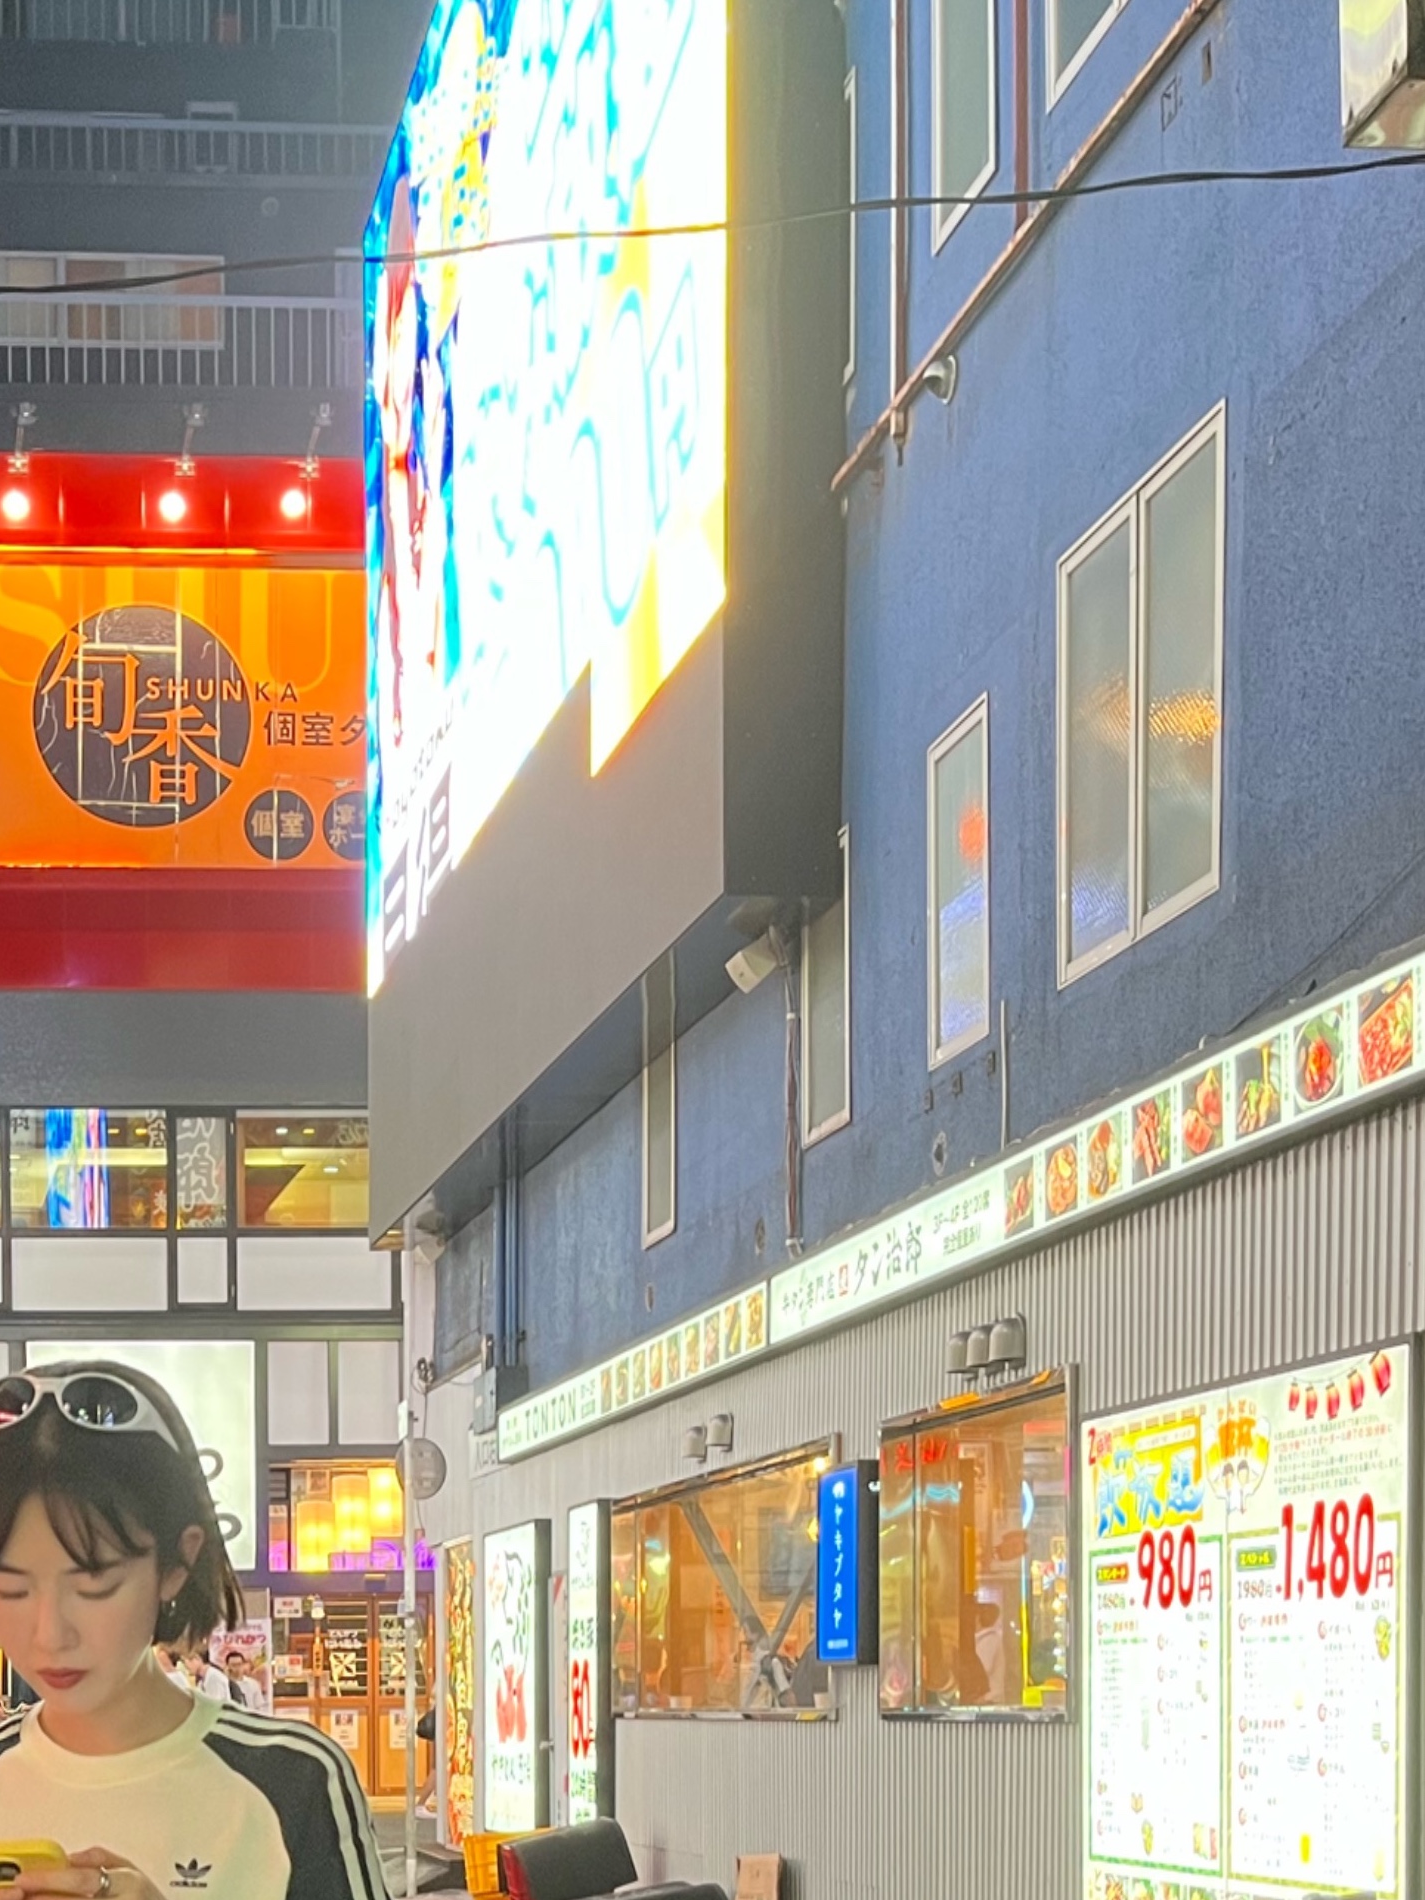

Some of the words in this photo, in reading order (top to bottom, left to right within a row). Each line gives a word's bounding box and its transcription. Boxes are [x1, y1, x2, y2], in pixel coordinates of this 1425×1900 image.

[146, 676, 299, 703] SHUNKA
[251, 809, 305, 840] 個室
[524, 1386, 576, 1442] TONTON
[1137, 1524, 1213, 1610] 980円
[1281, 1493, 1394, 1601] 1,480円
